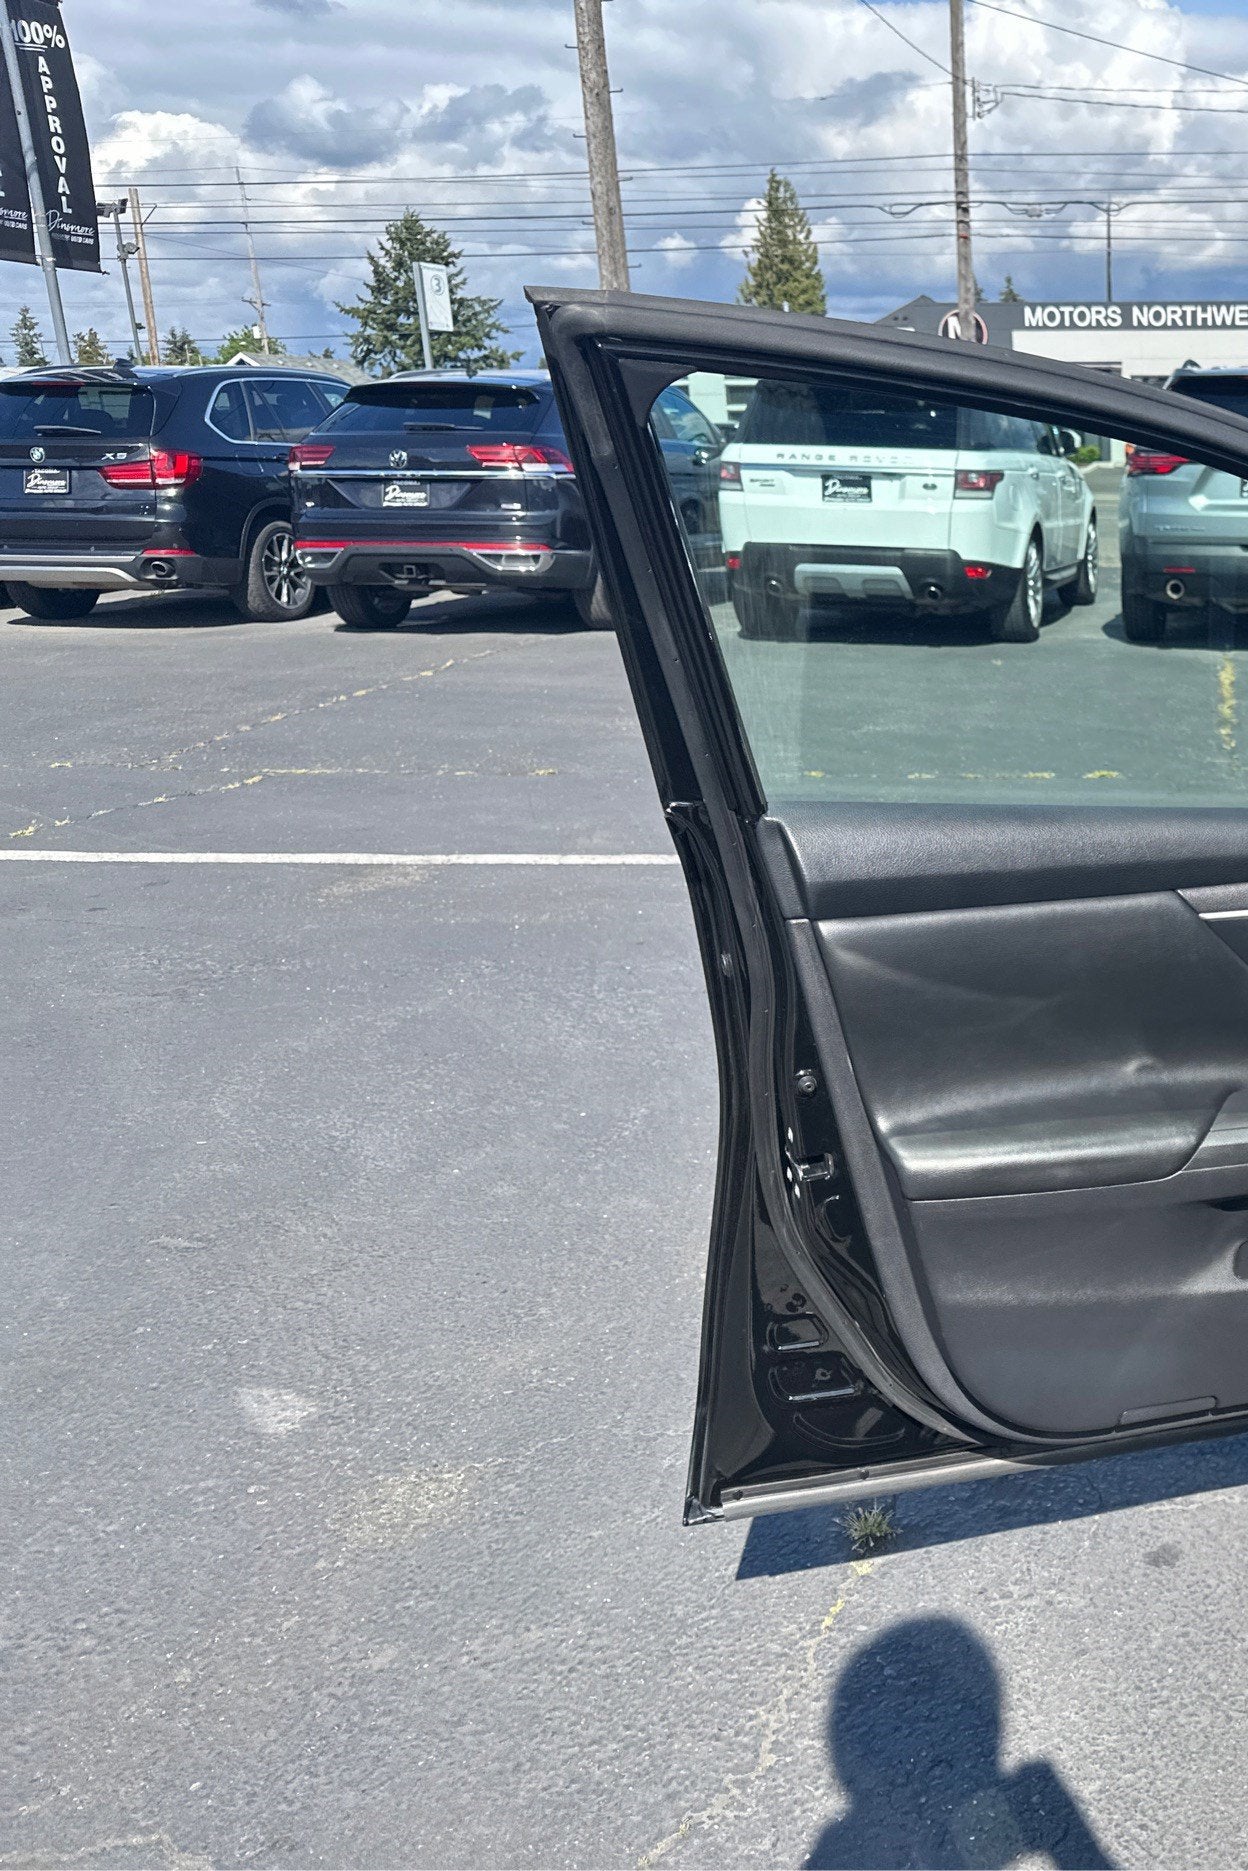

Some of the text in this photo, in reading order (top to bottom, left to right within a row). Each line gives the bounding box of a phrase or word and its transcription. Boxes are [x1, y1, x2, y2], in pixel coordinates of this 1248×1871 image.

[10, 19, 66, 49] 100%
[38, 55, 73, 214] APPROVAL
[1023, 305, 1122, 328] MOTORS
[776, 452, 837, 462] RANGE
